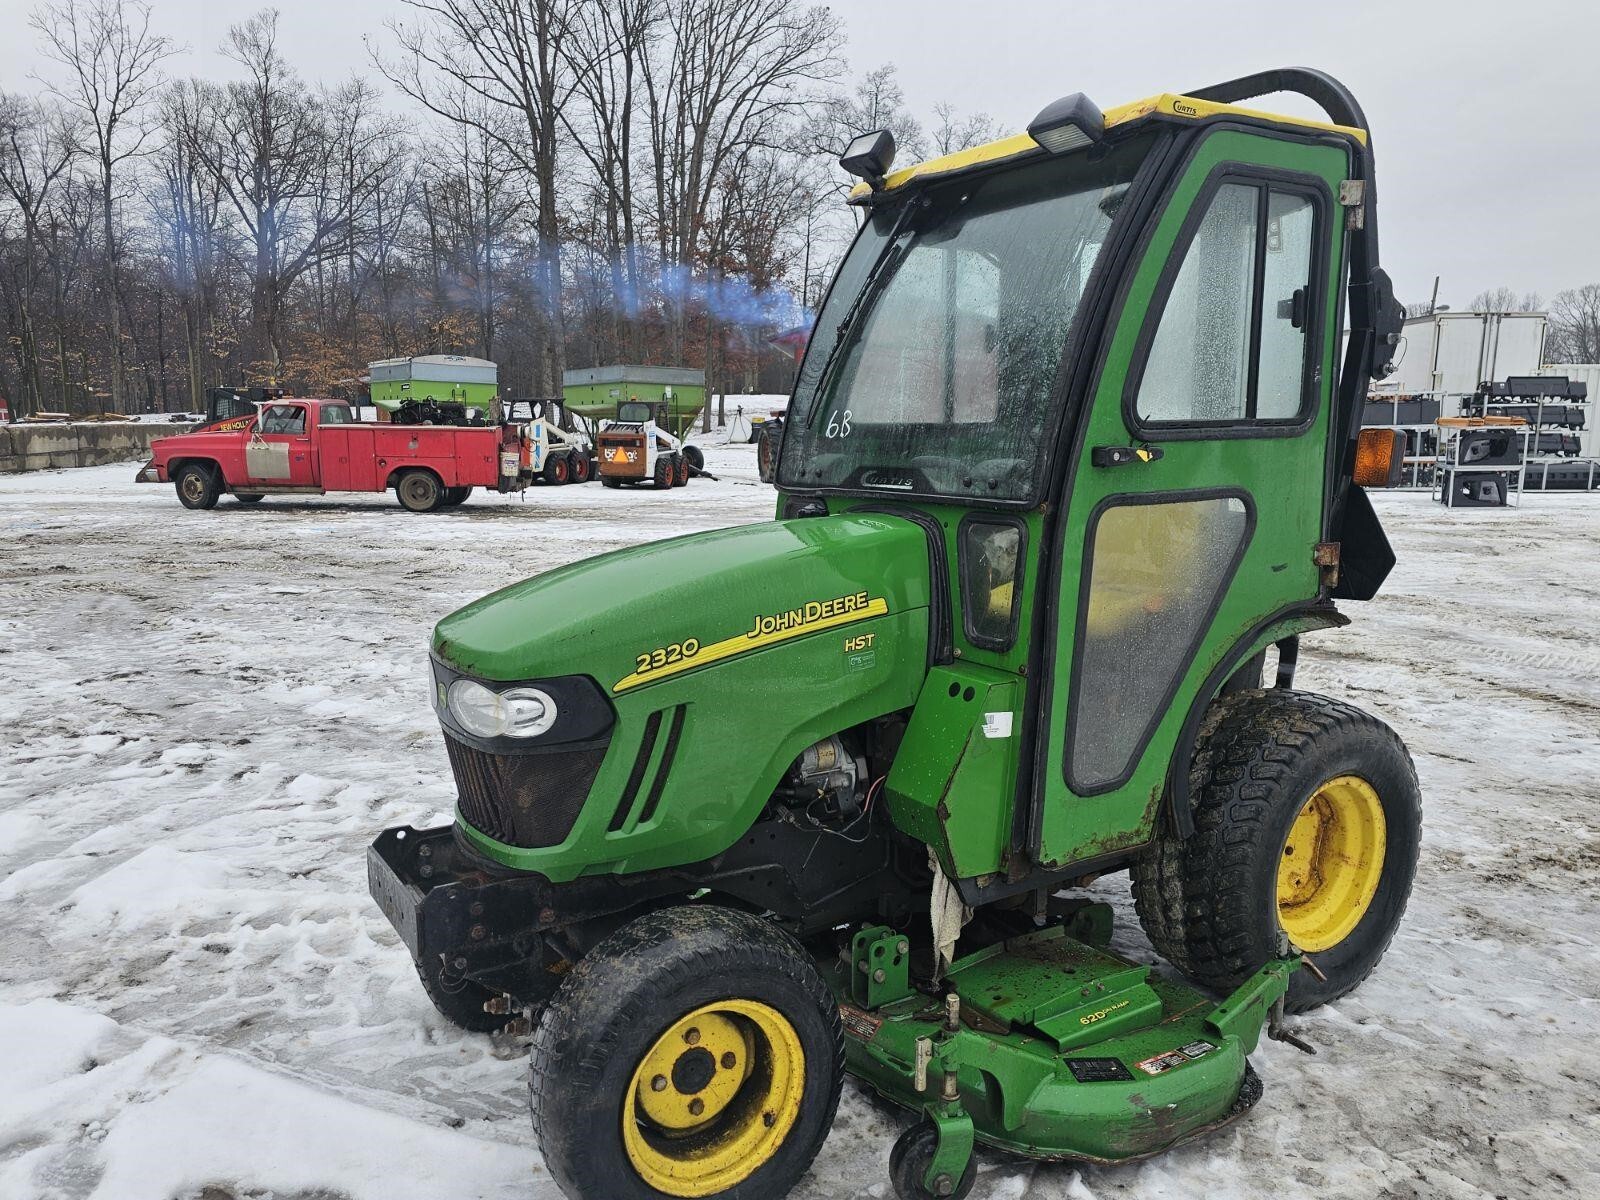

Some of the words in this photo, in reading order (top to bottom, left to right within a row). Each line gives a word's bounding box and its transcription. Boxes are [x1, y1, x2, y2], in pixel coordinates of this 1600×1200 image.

[1173, 100, 1197, 116] CURTIS
[860, 470, 914, 490] CURTIS
[636, 638, 700, 675] 2320
[746, 608, 803, 639] JOHN
[804, 591, 869, 624] DEERE
[844, 633, 876, 653] HST
